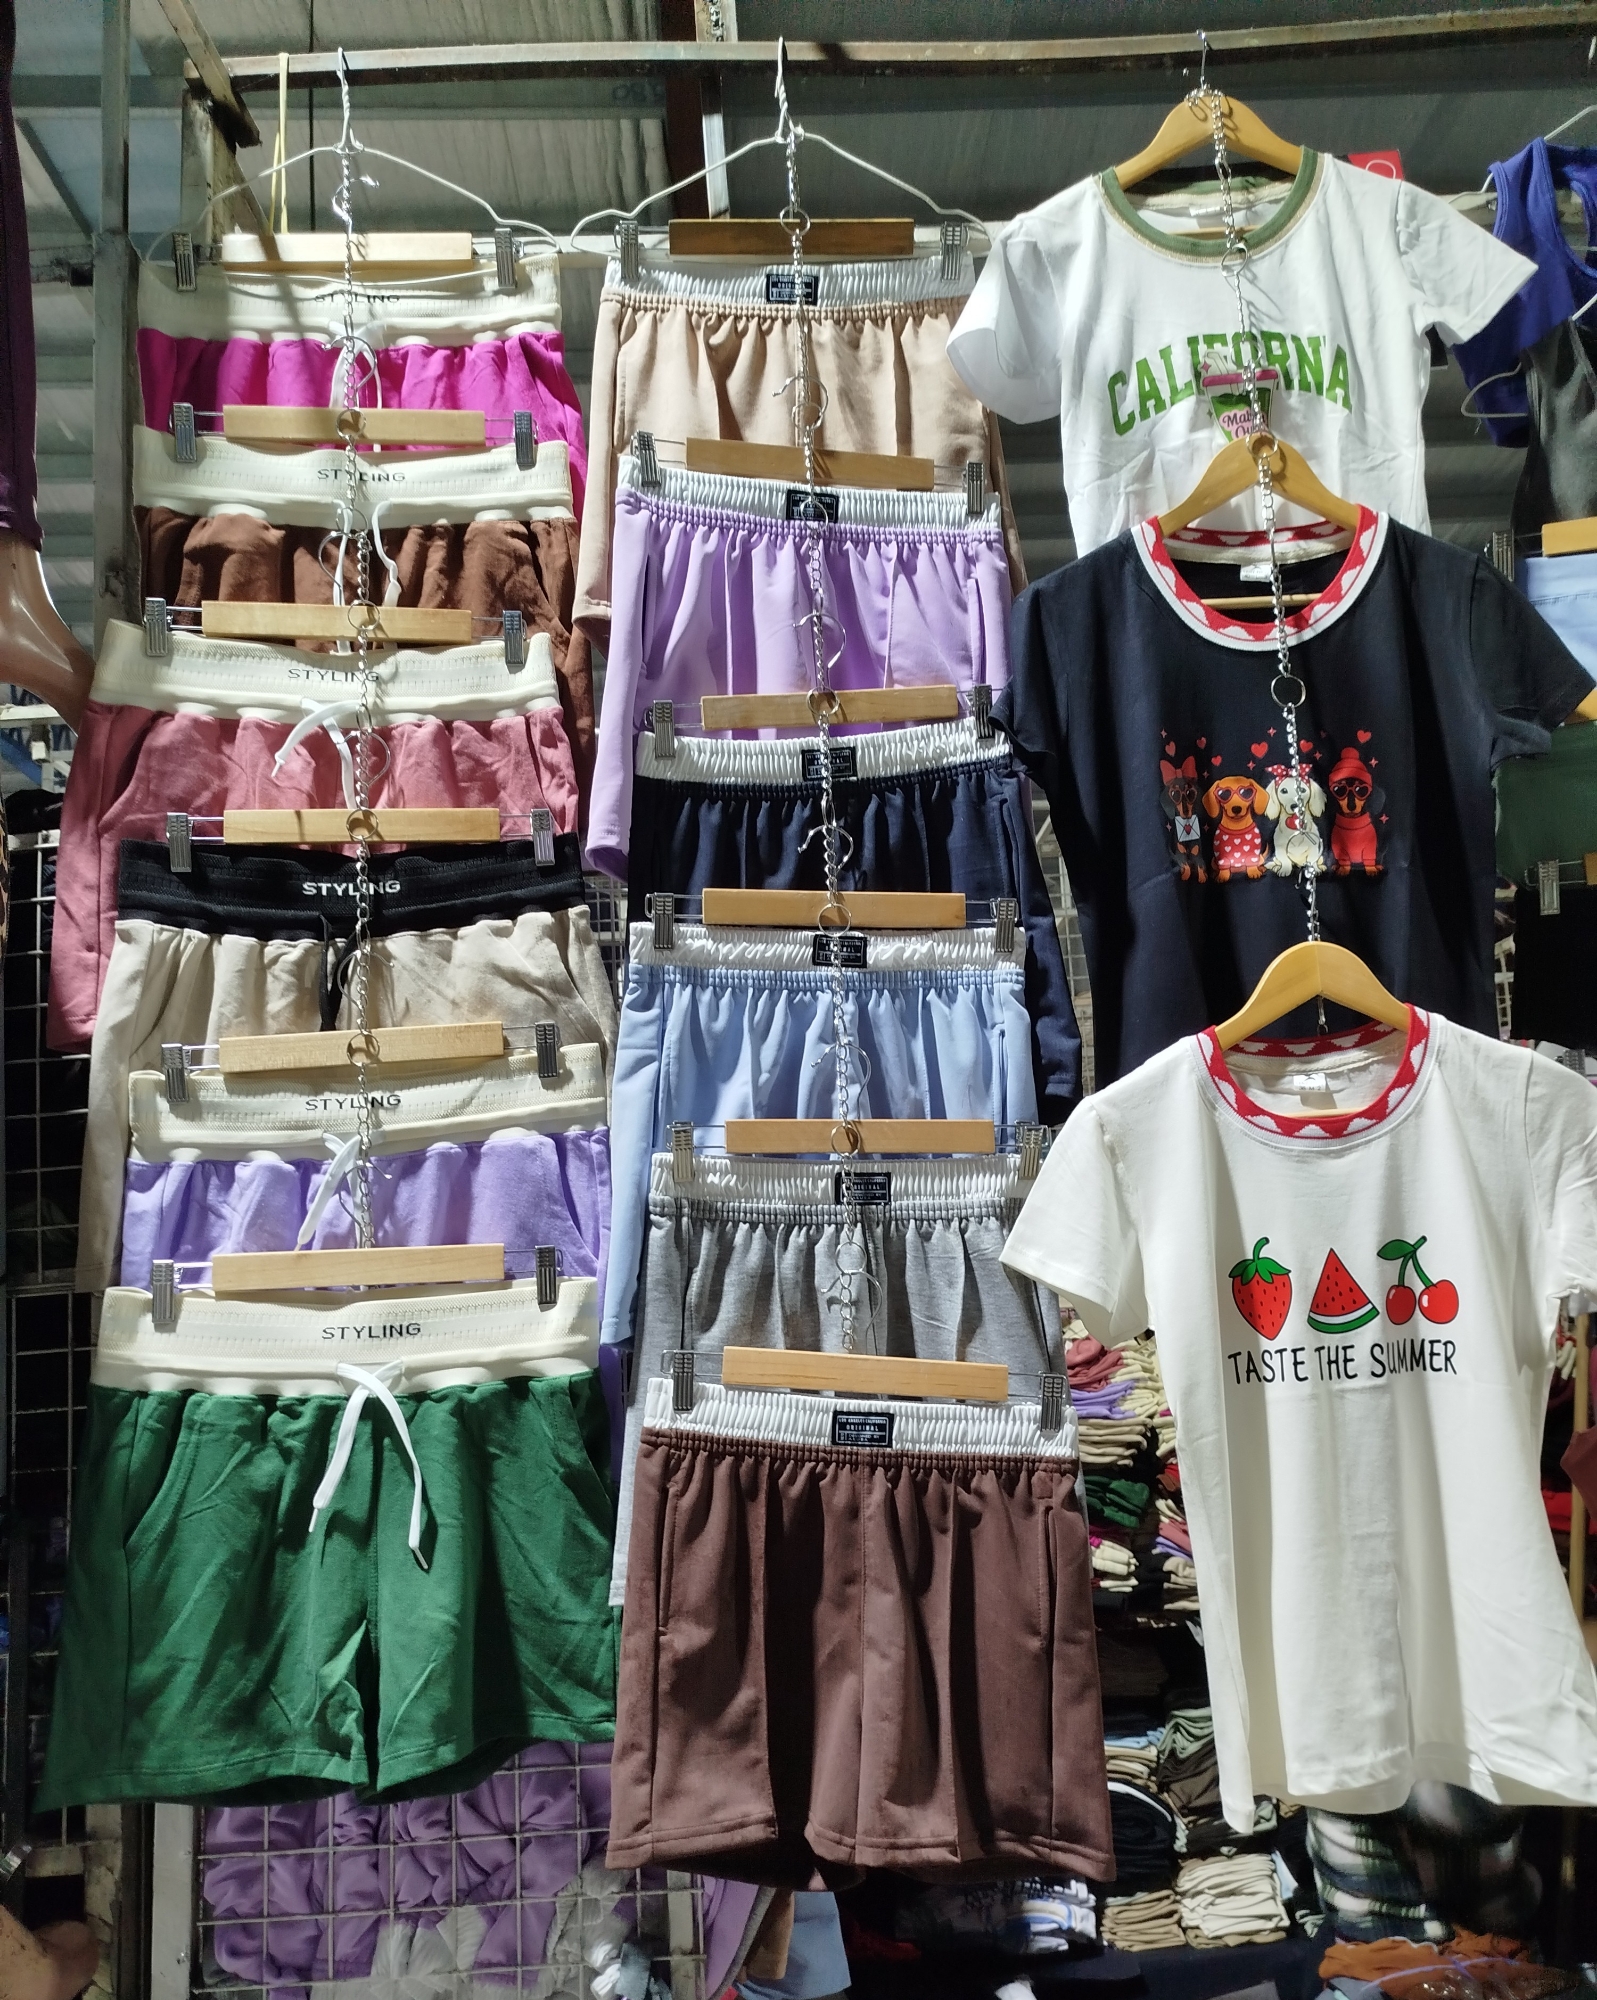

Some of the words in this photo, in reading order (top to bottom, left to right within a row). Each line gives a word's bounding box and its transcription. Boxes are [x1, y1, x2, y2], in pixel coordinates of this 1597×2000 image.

[322, 1322, 421, 1340] STYLING
[1227, 1346, 1309, 1384] TASTE
[1314, 1344, 1358, 1381] THE
[1370, 1338, 1457, 1379] SUMMER
